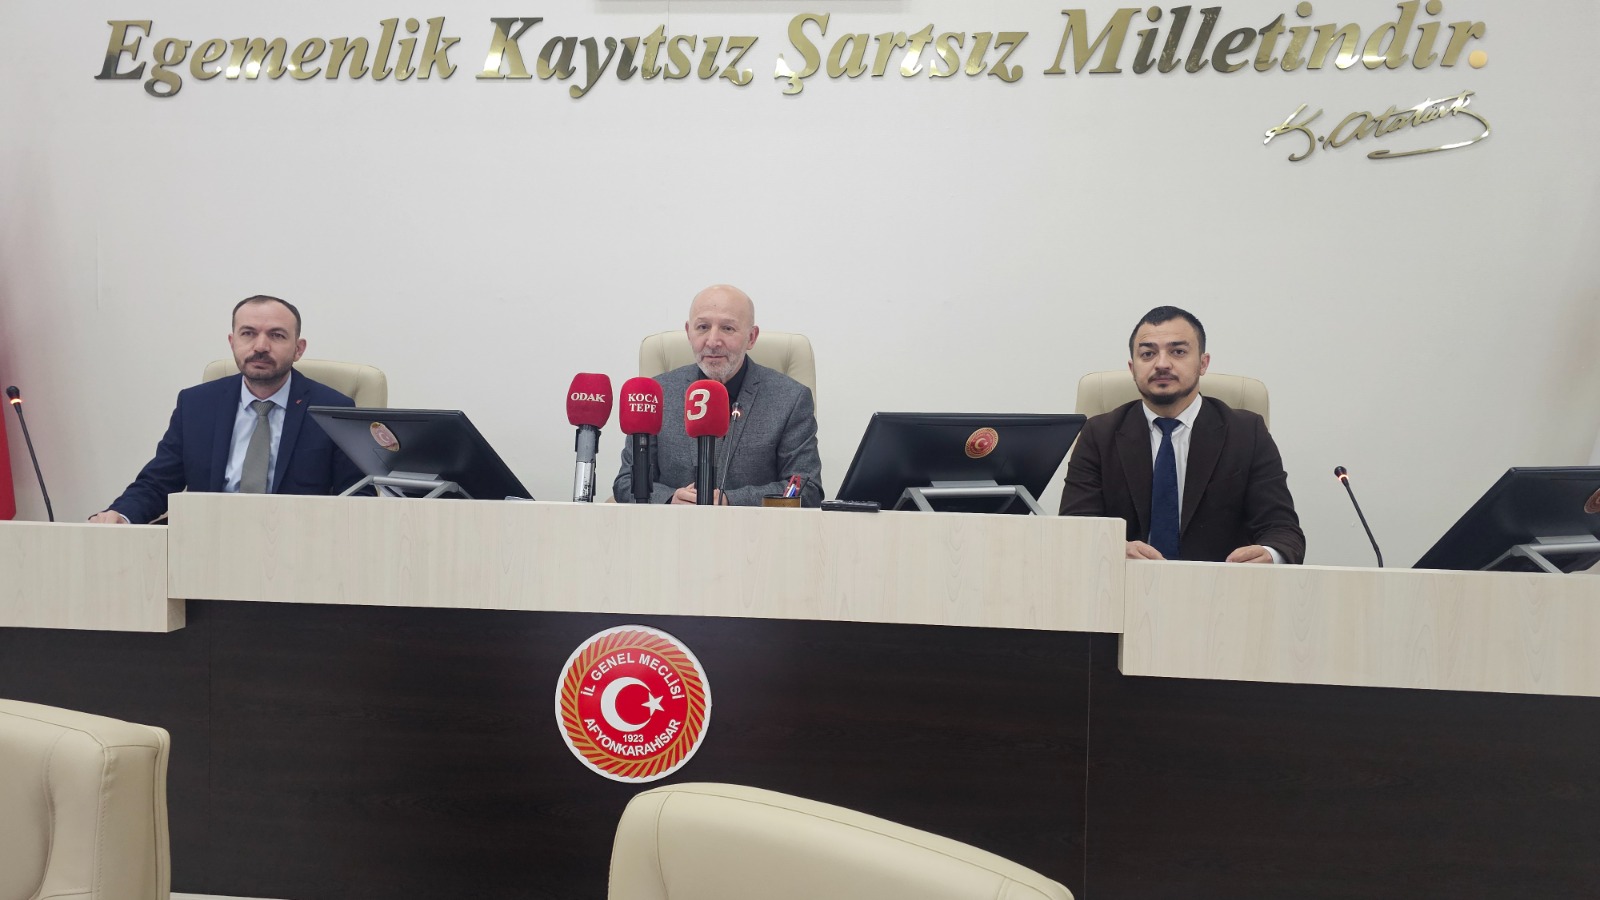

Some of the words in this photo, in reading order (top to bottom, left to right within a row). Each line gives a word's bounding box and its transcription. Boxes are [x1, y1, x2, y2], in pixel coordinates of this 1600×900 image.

[94, 15, 460, 98] Egemenlik
[475, 16, 760, 99] Kayıtsız
[774, 12, 1030, 95] Şartsız
[571, 392, 605, 403] ODAK
[627, 393, 659, 404] KOCA
[629, 403, 657, 413] TEPE
[686, 388, 711, 421] 3
[580, 684, 596, 697] İL
[590, 652, 635, 681] GENEL
[638, 653, 685, 700] MECLİSİ
[583, 718, 681, 757] AFYONKARAHİSAR
[622, 734, 644, 743] 1923
